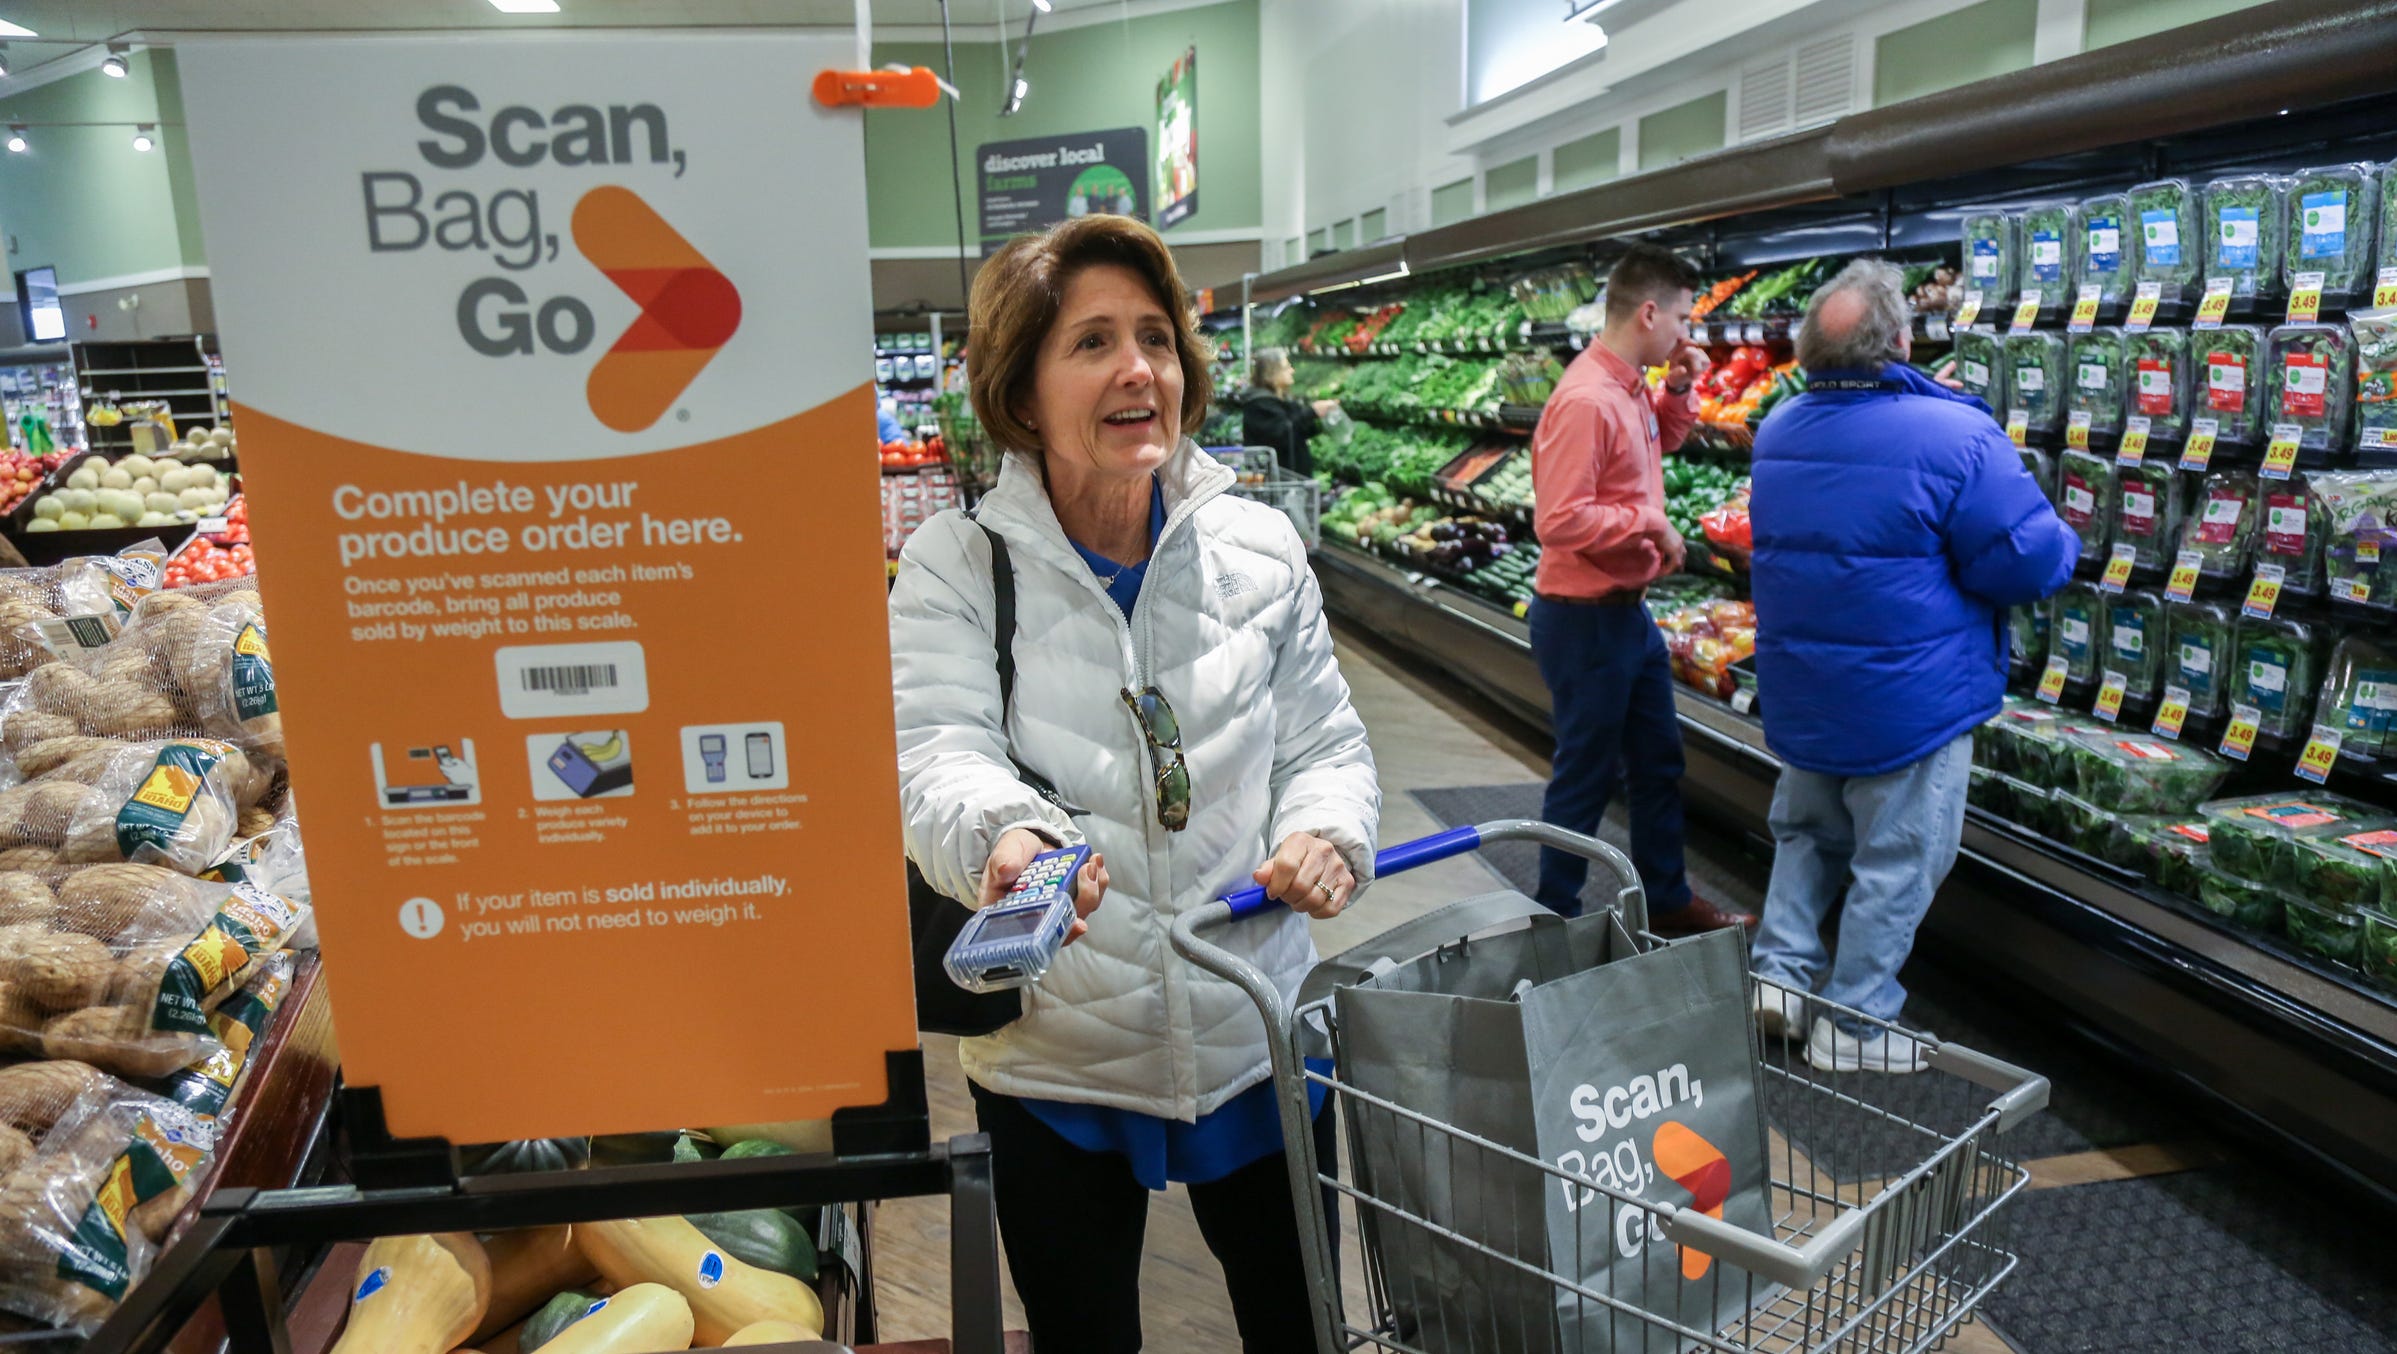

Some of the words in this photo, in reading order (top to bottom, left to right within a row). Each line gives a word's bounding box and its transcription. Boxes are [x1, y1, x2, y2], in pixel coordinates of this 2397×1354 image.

[415, 85, 687, 178] Scan,
[984, 148, 1056, 173] discover
[1059, 143, 1105, 166] local
[361, 171, 558, 270] Bag,
[2292, 295, 2317, 310] 3.49
[2378, 295, 2397, 306] 3.4
[457, 277, 597, 357] Go
[2269, 446, 2294, 461] 3.49
[333, 481, 534, 522] Complete
[545, 479, 639, 518] your
[339, 522, 509, 566] produce
[522, 515, 630, 551] order
[641, 512, 743, 545] here.
[344, 576, 401, 595] Once
[406, 573, 476, 596] you've
[480, 566, 570, 587] scanned
[575, 564, 626, 583] each
[631, 561, 693, 582] item's
[2253, 585, 2276, 600] 3.49
[347, 598, 441, 619] barcode,
[445, 594, 500, 616] bring
[506, 592, 530, 610] all
[534, 591, 621, 613] produce
[351, 621, 396, 641] sold
[400, 621, 426, 641] by
[431, 615, 503, 639] weight
[506, 616, 529, 633] to
[533, 612, 572, 632] this
[577, 612, 637, 630] scale.
[2230, 725, 2253, 741] 3.49
[2306, 747, 2332, 764] 3.49
[457, 892, 470, 911] If
[476, 895, 524, 915] your
[531, 889, 577, 907] item
[583, 887, 601, 904] is
[605, 882, 655, 903] sold
[660, 875, 792, 899] individually,
[460, 922, 502, 942] you
[506, 916, 541, 934] will
[546, 914, 583, 932] not
[587, 910, 642, 930] need
[646, 908, 670, 926] to
[673, 904, 738, 927] weigh
[743, 903, 762, 920] it.
[161, 993, 181, 1005] NET
[1571, 1063, 1703, 1143] Scan,
[1557, 1138, 1654, 1213] Bag,
